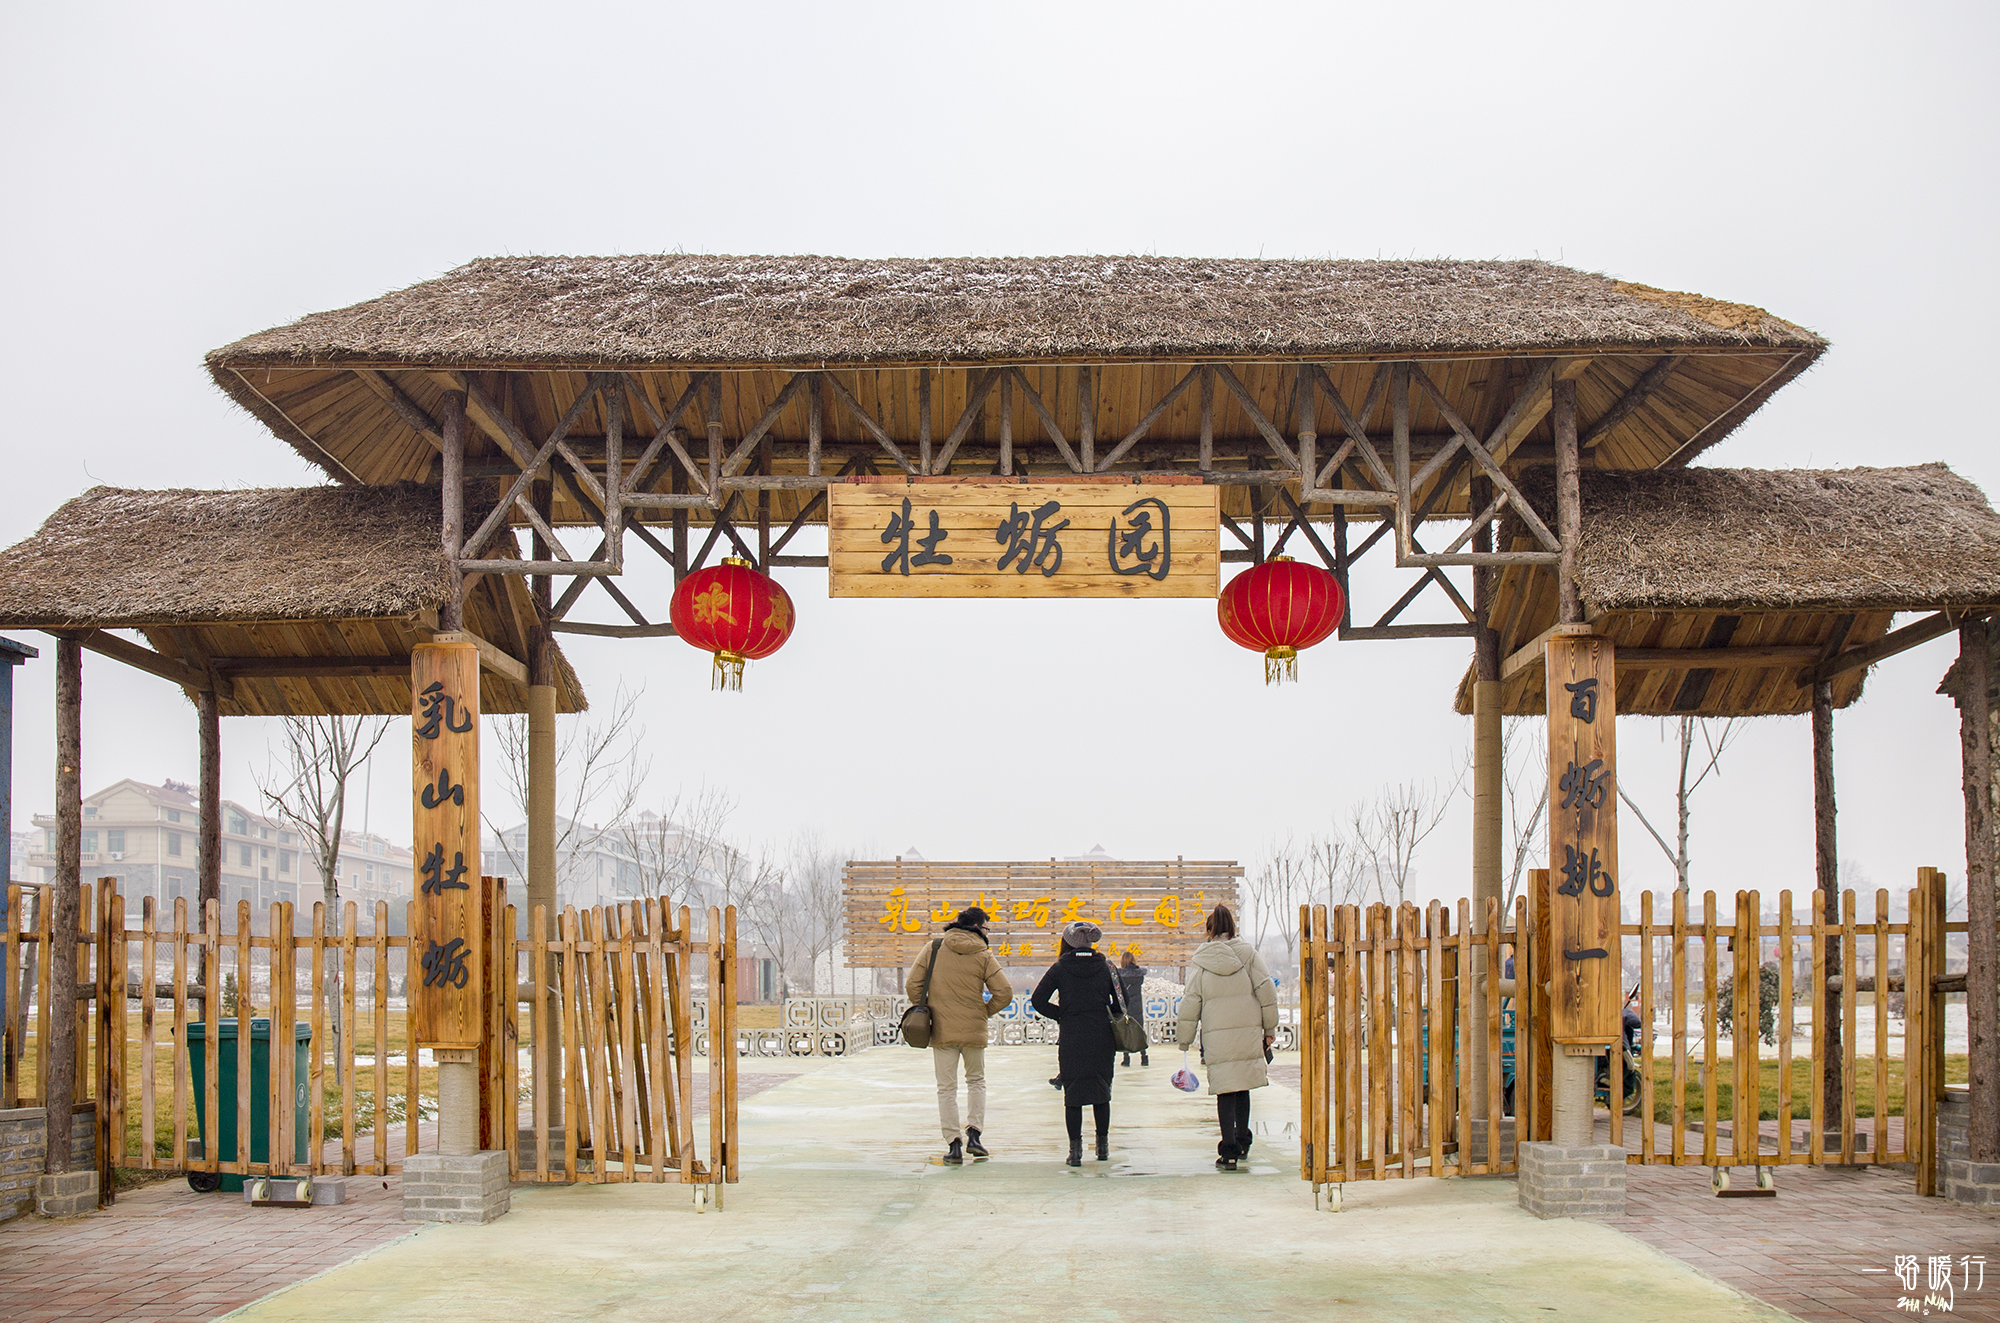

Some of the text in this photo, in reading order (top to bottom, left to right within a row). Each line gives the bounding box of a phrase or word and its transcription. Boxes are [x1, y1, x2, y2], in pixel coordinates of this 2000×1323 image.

[881, 497, 1172, 582] 牡蛎园
[415, 681, 474, 990] 乳山牡蛎
[1557, 677, 1615, 962] 百蛎挑一
